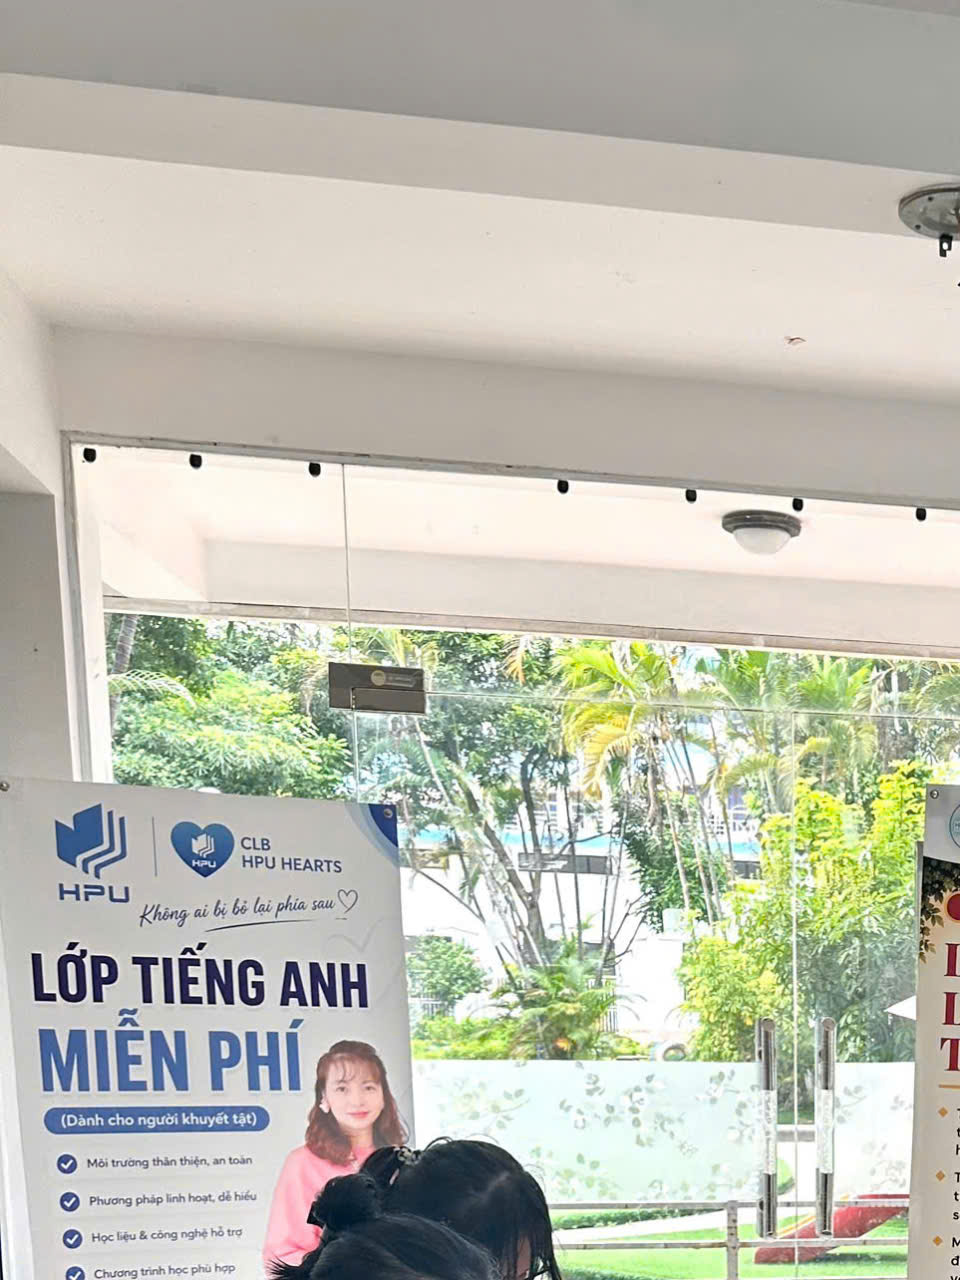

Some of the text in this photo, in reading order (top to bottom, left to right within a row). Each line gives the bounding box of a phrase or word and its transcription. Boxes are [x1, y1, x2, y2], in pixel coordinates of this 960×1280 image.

[241, 837, 271, 850] CLB
[192, 860, 217, 868] HPU
[242, 855, 342, 873] HPU HEARTS
[58, 883, 130, 903] HPU
[139, 895, 336, 927] Không ai bị bỏ lại phía sau
[31, 942, 369, 1008] LỚP TIẾNG ANH
[38, 1008, 304, 1092] MIỄN PHÍ
[61, 1112, 256, 1128] (Dành cho người khuyết tật)
[92, 1233, 114, 1244] Học
[139, 1231, 149, 1240] &
[168, 1265, 188, 1276] học
